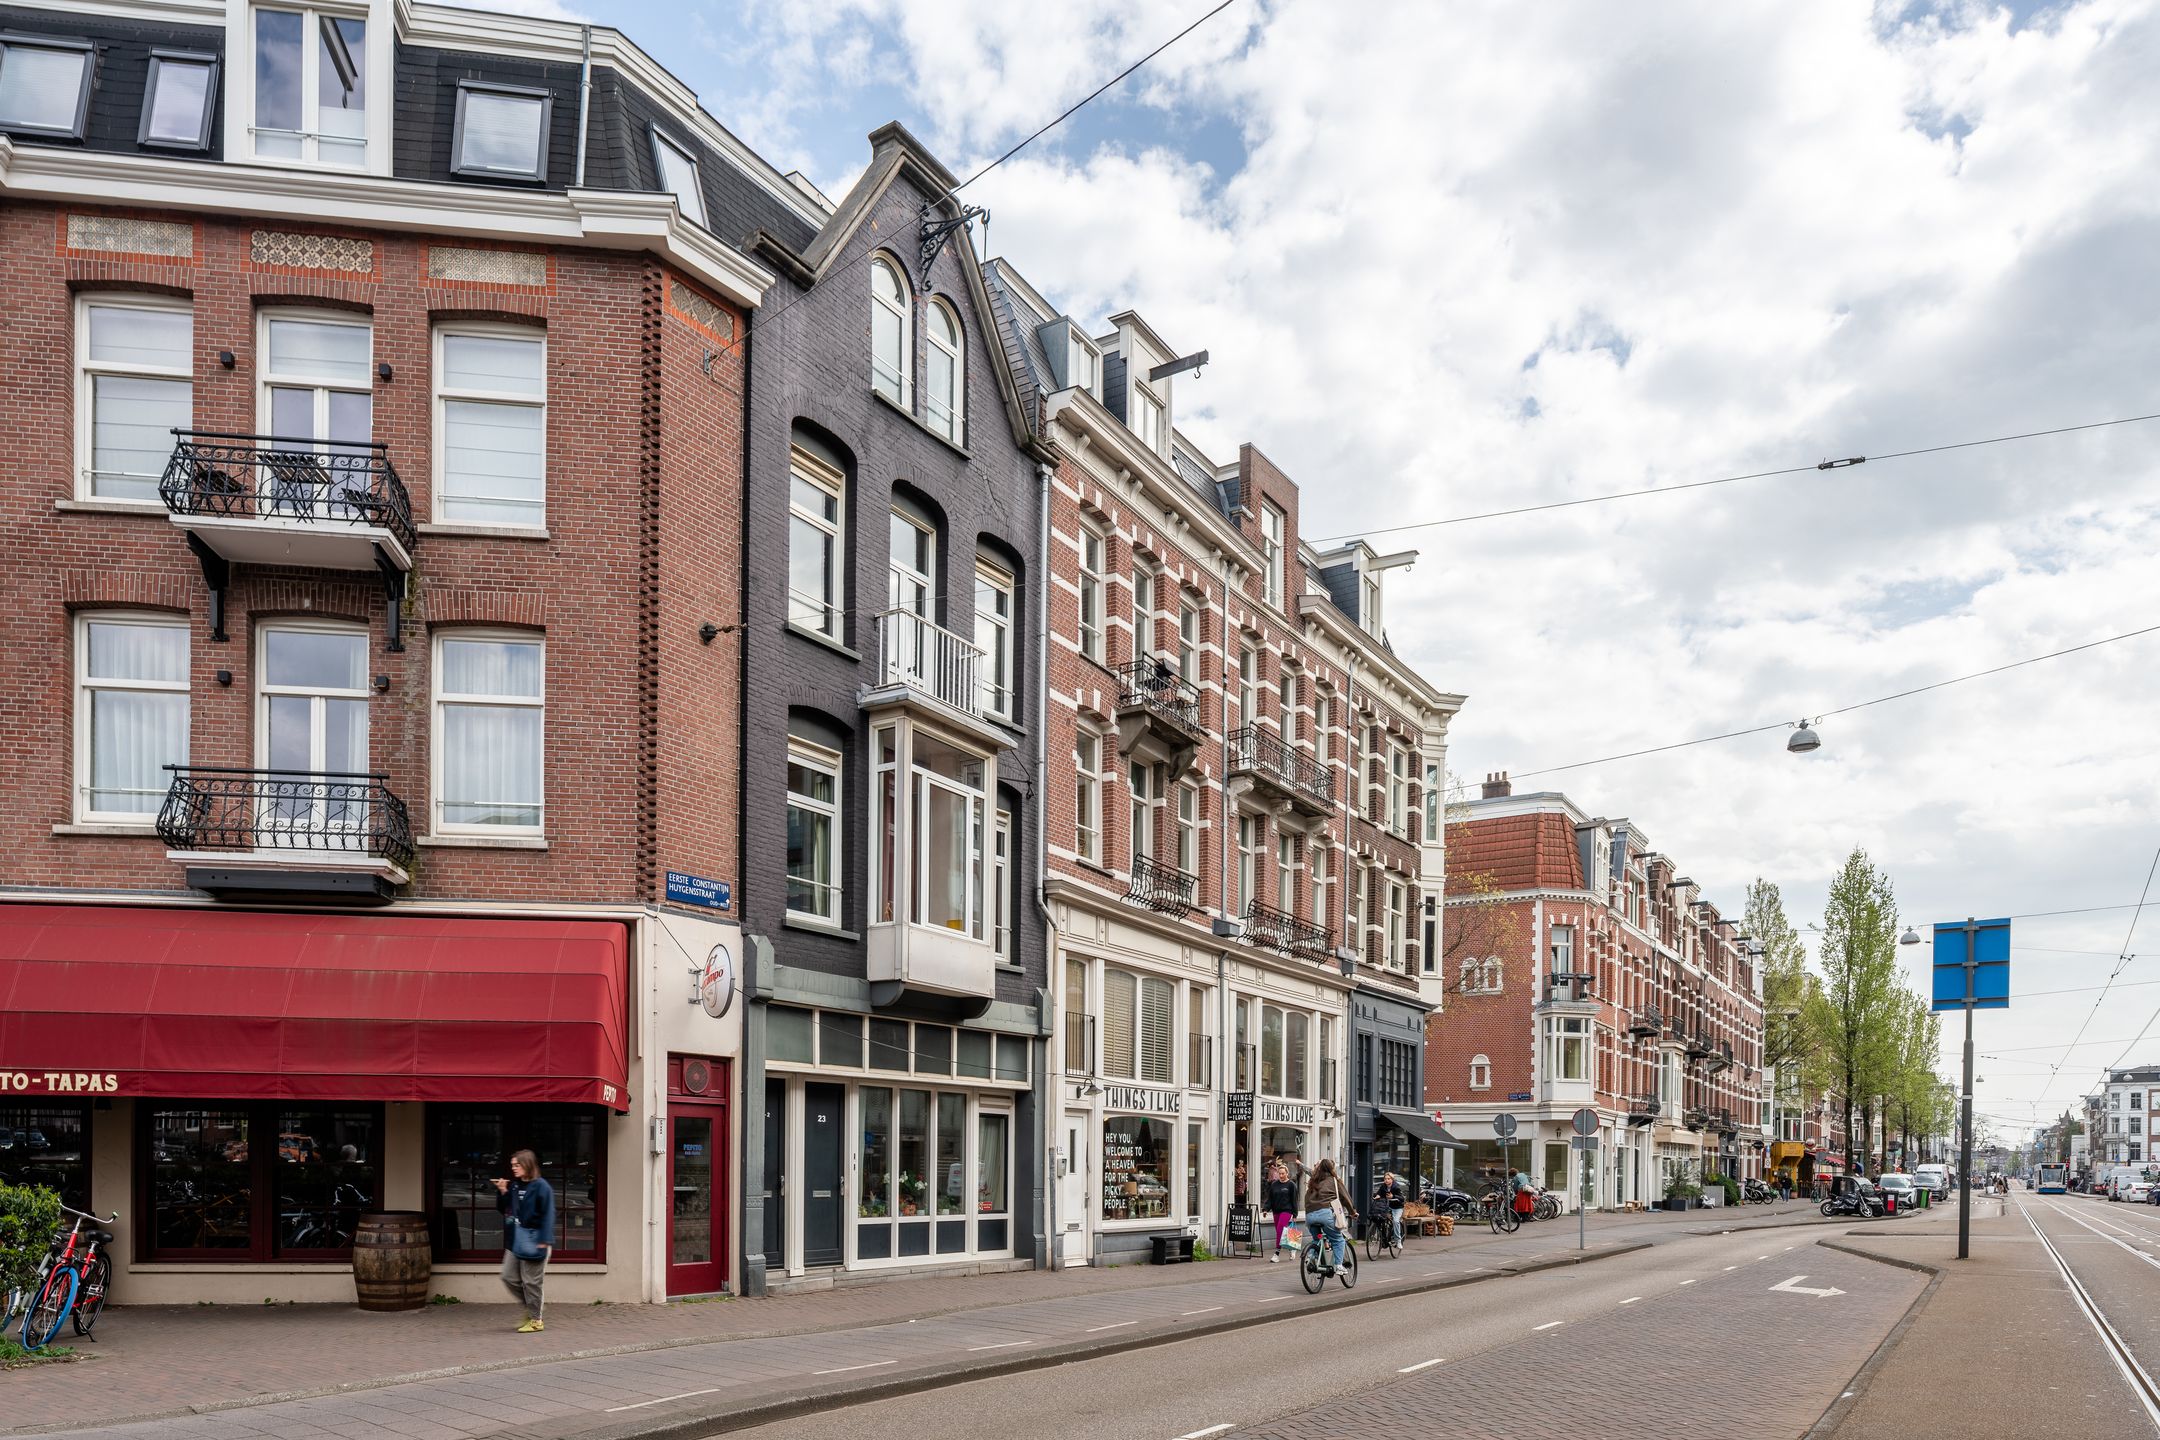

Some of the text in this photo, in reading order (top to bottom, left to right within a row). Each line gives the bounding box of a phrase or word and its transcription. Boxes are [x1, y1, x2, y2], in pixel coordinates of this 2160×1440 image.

[668, 873, 729, 894] EERSTE CONSTANTIJN
[668, 882, 716, 900] HUYGENSSTRAAT
[1103, 1086, 1180, 1113] THINGS I LIKE
[817, 1114, 827, 1123] 23
[1261, 1103, 1290, 1121] THINGS
[1295, 1105, 1314, 1123] LOVE
[1105, 1132, 1133, 1144] HEY YOU,
[1104, 1146, 1143, 1157] WELCOME TO
[1105, 1160, 1135, 1170] A HEAVEN
[1104, 1172, 1129, 1183] FOR THE
[1104, 1185, 1121, 1196] PICKY
[1104, 1199, 1128, 1209] PEOPLE.
